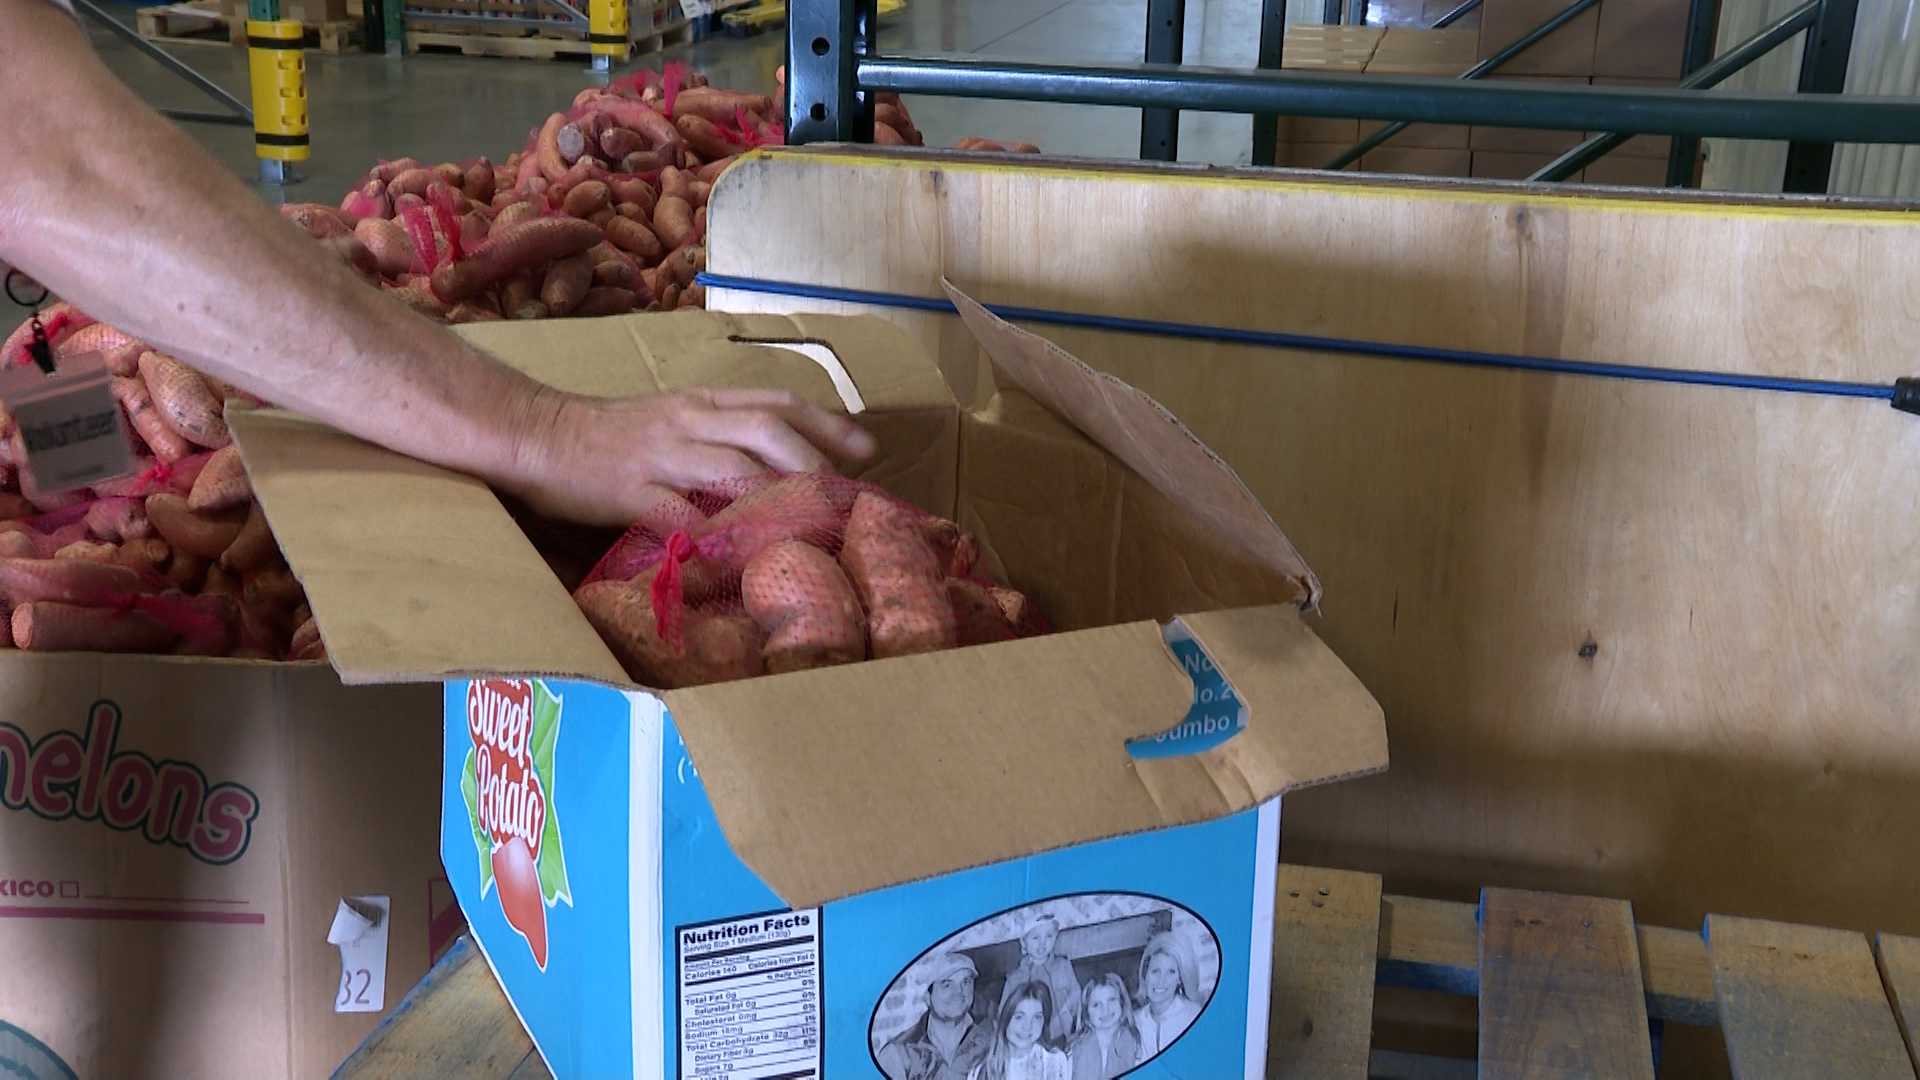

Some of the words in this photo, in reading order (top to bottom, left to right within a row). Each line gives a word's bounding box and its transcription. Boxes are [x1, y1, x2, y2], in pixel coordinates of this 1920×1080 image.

[469, 678, 530, 770] Sweet
[477, 744, 543, 848] Potato
[683, 923, 759, 945] Nutrition
[764, 915, 810, 931] Facts
[748, 958, 777, 970] Calories
[685, 968, 721, 980] Calories
[685, 996, 706, 1006] Total
[686, 1041, 707, 1052] Total
[709, 1033, 769, 1048] Carbohydrate
